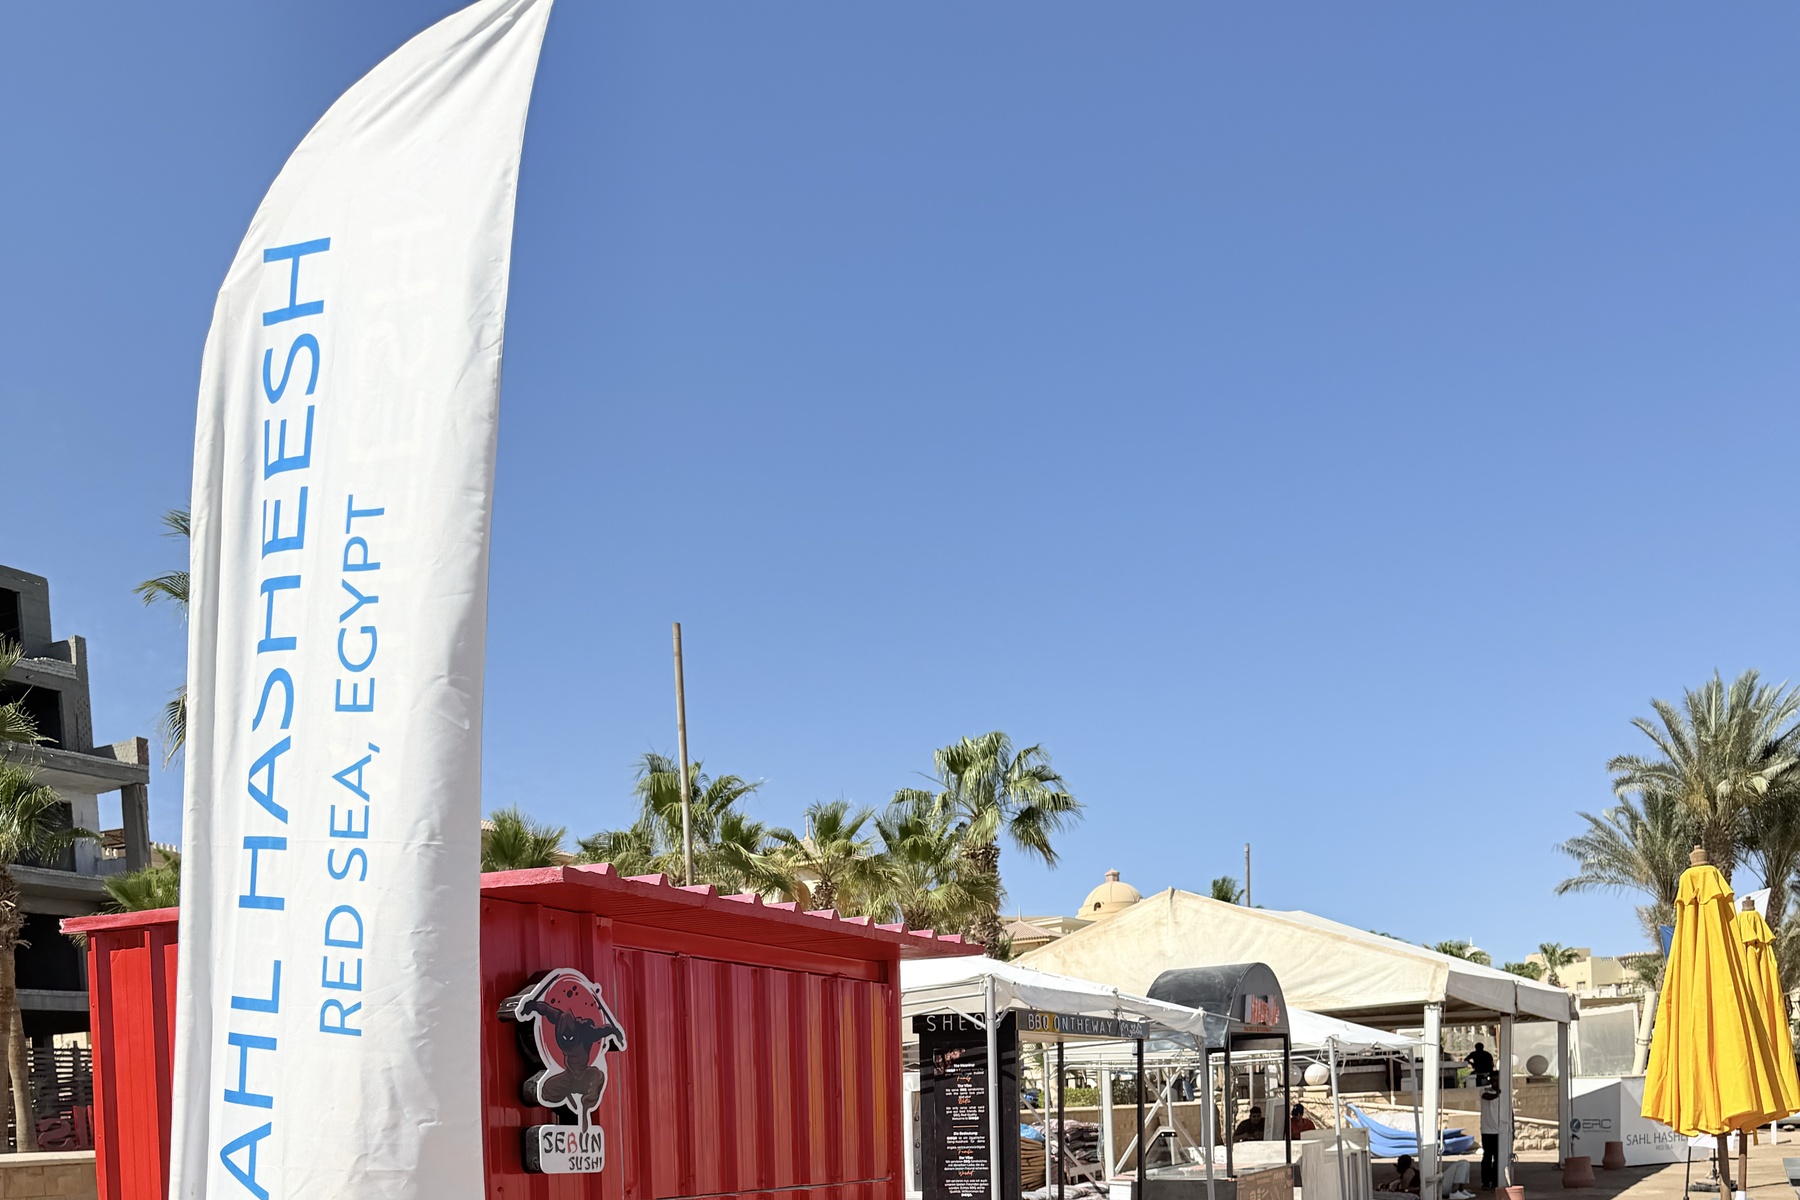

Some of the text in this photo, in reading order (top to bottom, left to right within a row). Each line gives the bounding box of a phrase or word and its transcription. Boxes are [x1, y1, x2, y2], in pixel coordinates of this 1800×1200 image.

[239, 236, 331, 911] HASHEESH
[320, 495, 385, 1038] RED SEA, EGYPT
[1028, 1013, 1049, 1031] BBQ
[1626, 1132, 1651, 1146] SAHL
[568, 1156, 602, 1171] SUSHI
